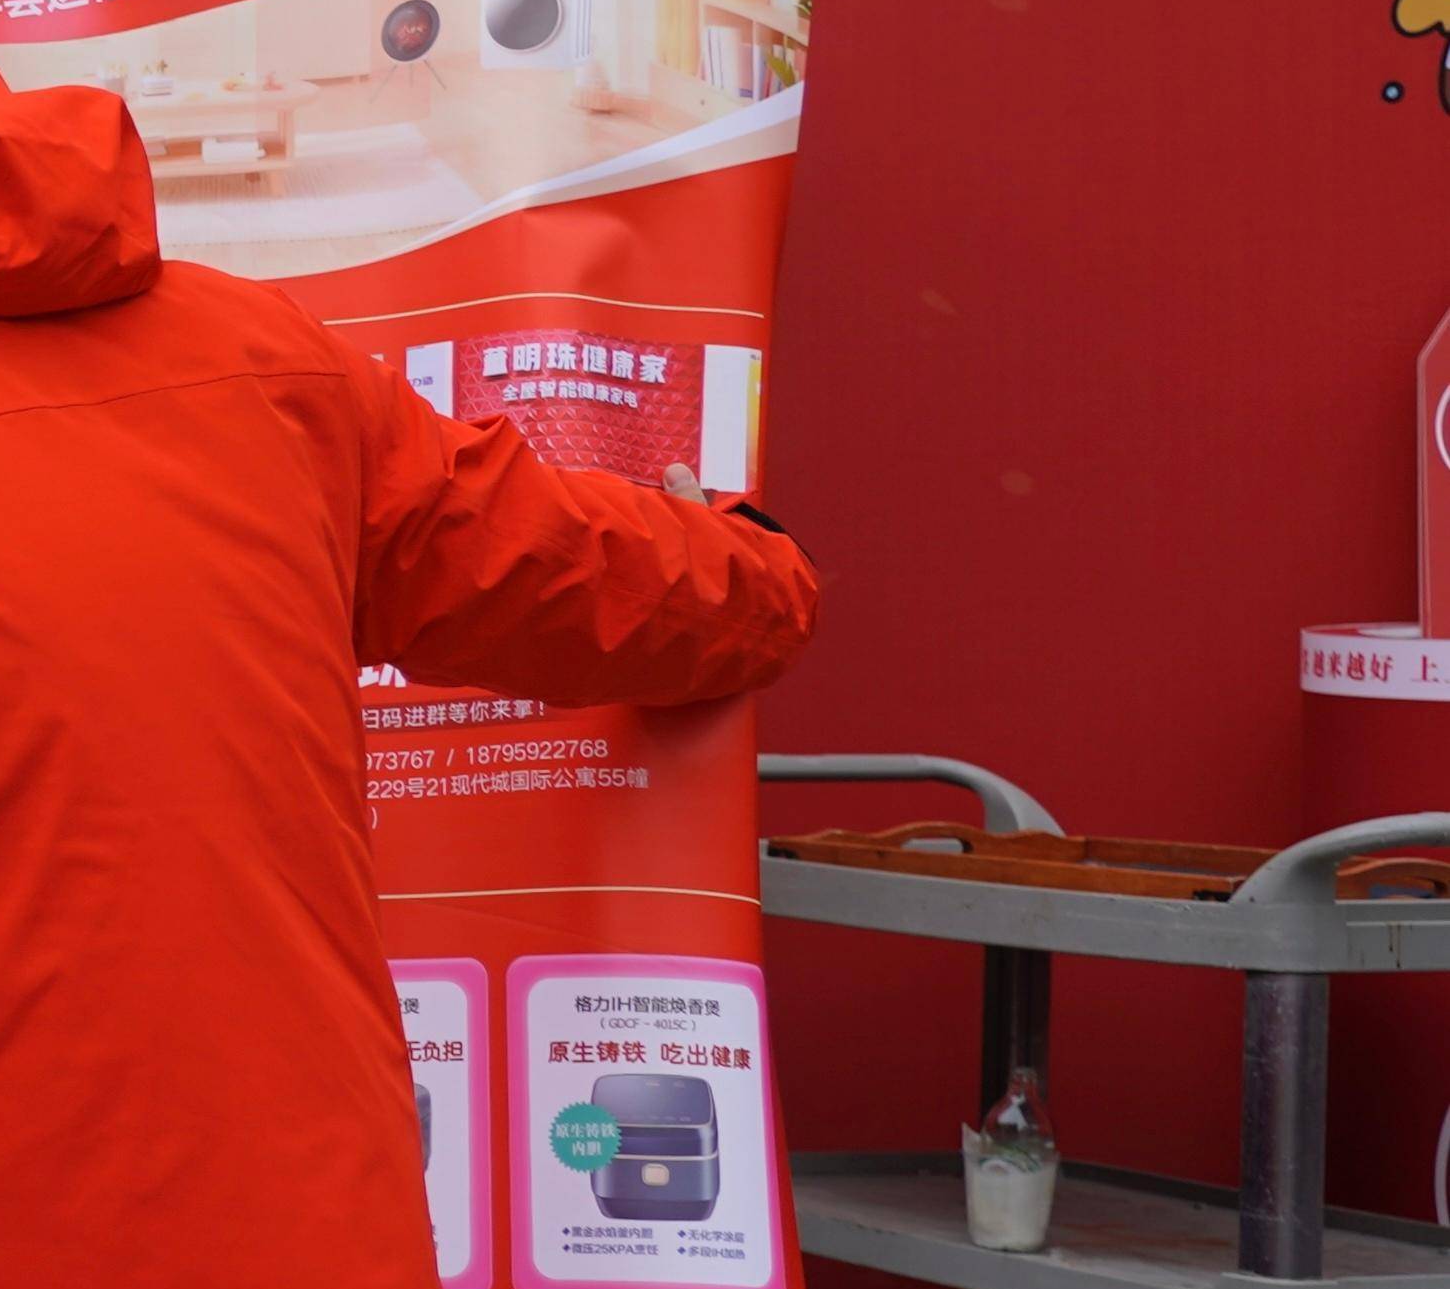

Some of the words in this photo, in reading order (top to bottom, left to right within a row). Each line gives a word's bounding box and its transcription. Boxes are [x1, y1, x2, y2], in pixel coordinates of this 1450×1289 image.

[481, 341, 668, 385] 董明珠健康家
[502, 380, 639, 409] 全屋智能健康家电
[466, 739, 609, 766] 18795922768
[574, 994, 722, 1018] 格力IH智能焕香煲
[547, 1039, 647, 1065] 原生铸铁
[660, 1042, 752, 1071] 吃出健康
